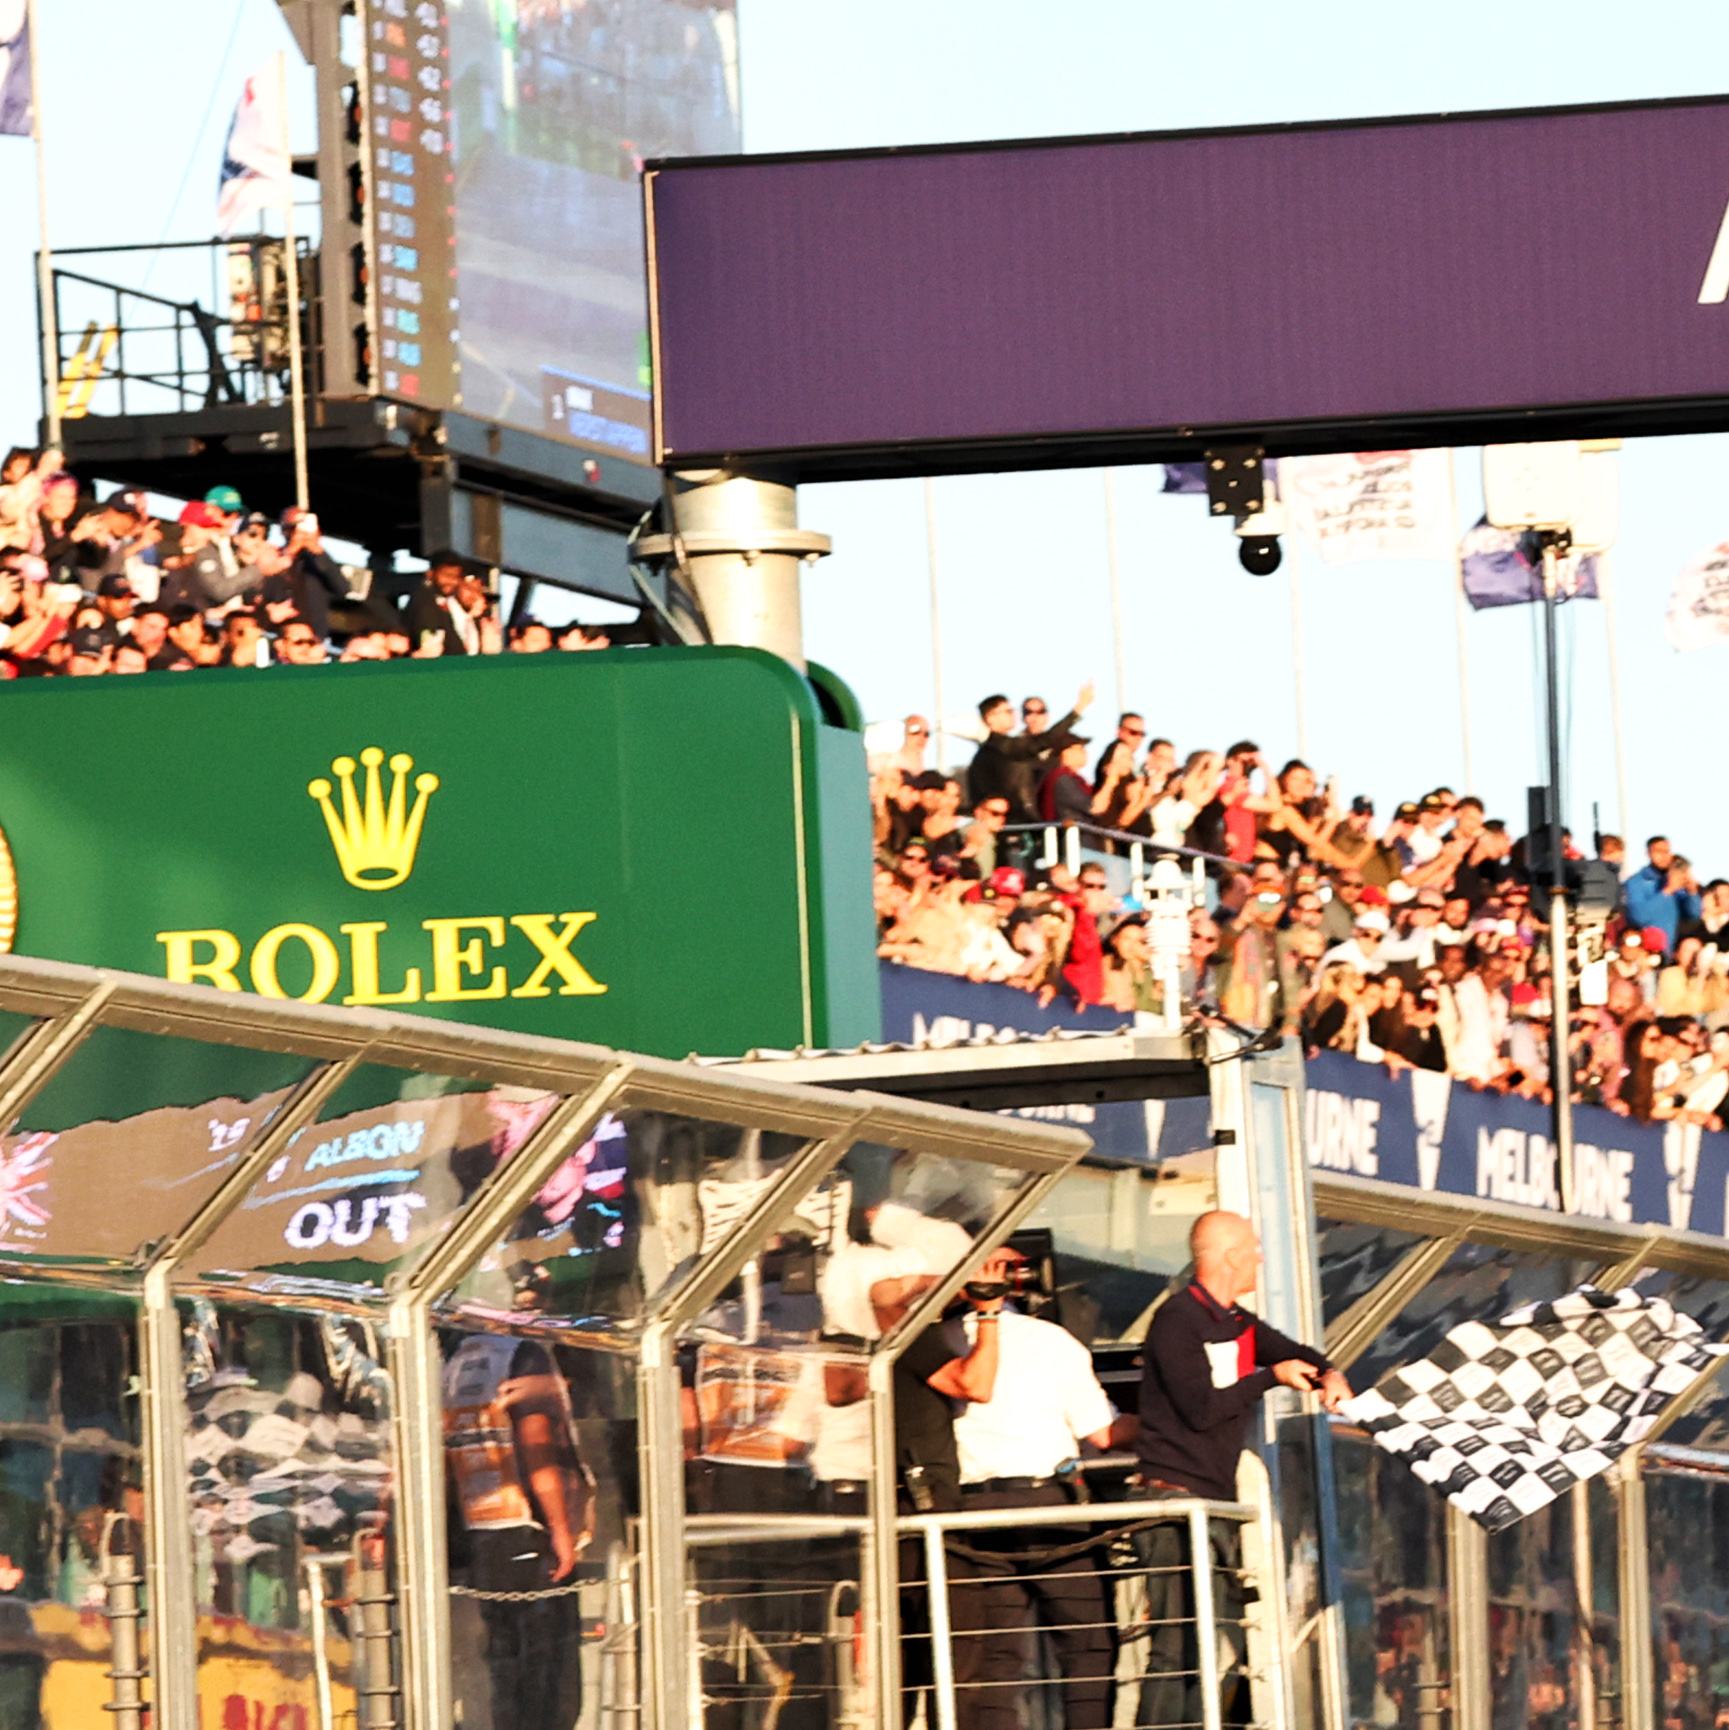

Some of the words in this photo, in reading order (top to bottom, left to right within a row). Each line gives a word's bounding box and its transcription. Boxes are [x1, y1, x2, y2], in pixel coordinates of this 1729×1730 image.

[155, 911, 609, 1006] ROLEX
[305, 1120, 425, 1171] ALBON
[284, 1193, 426, 1248] OUT
